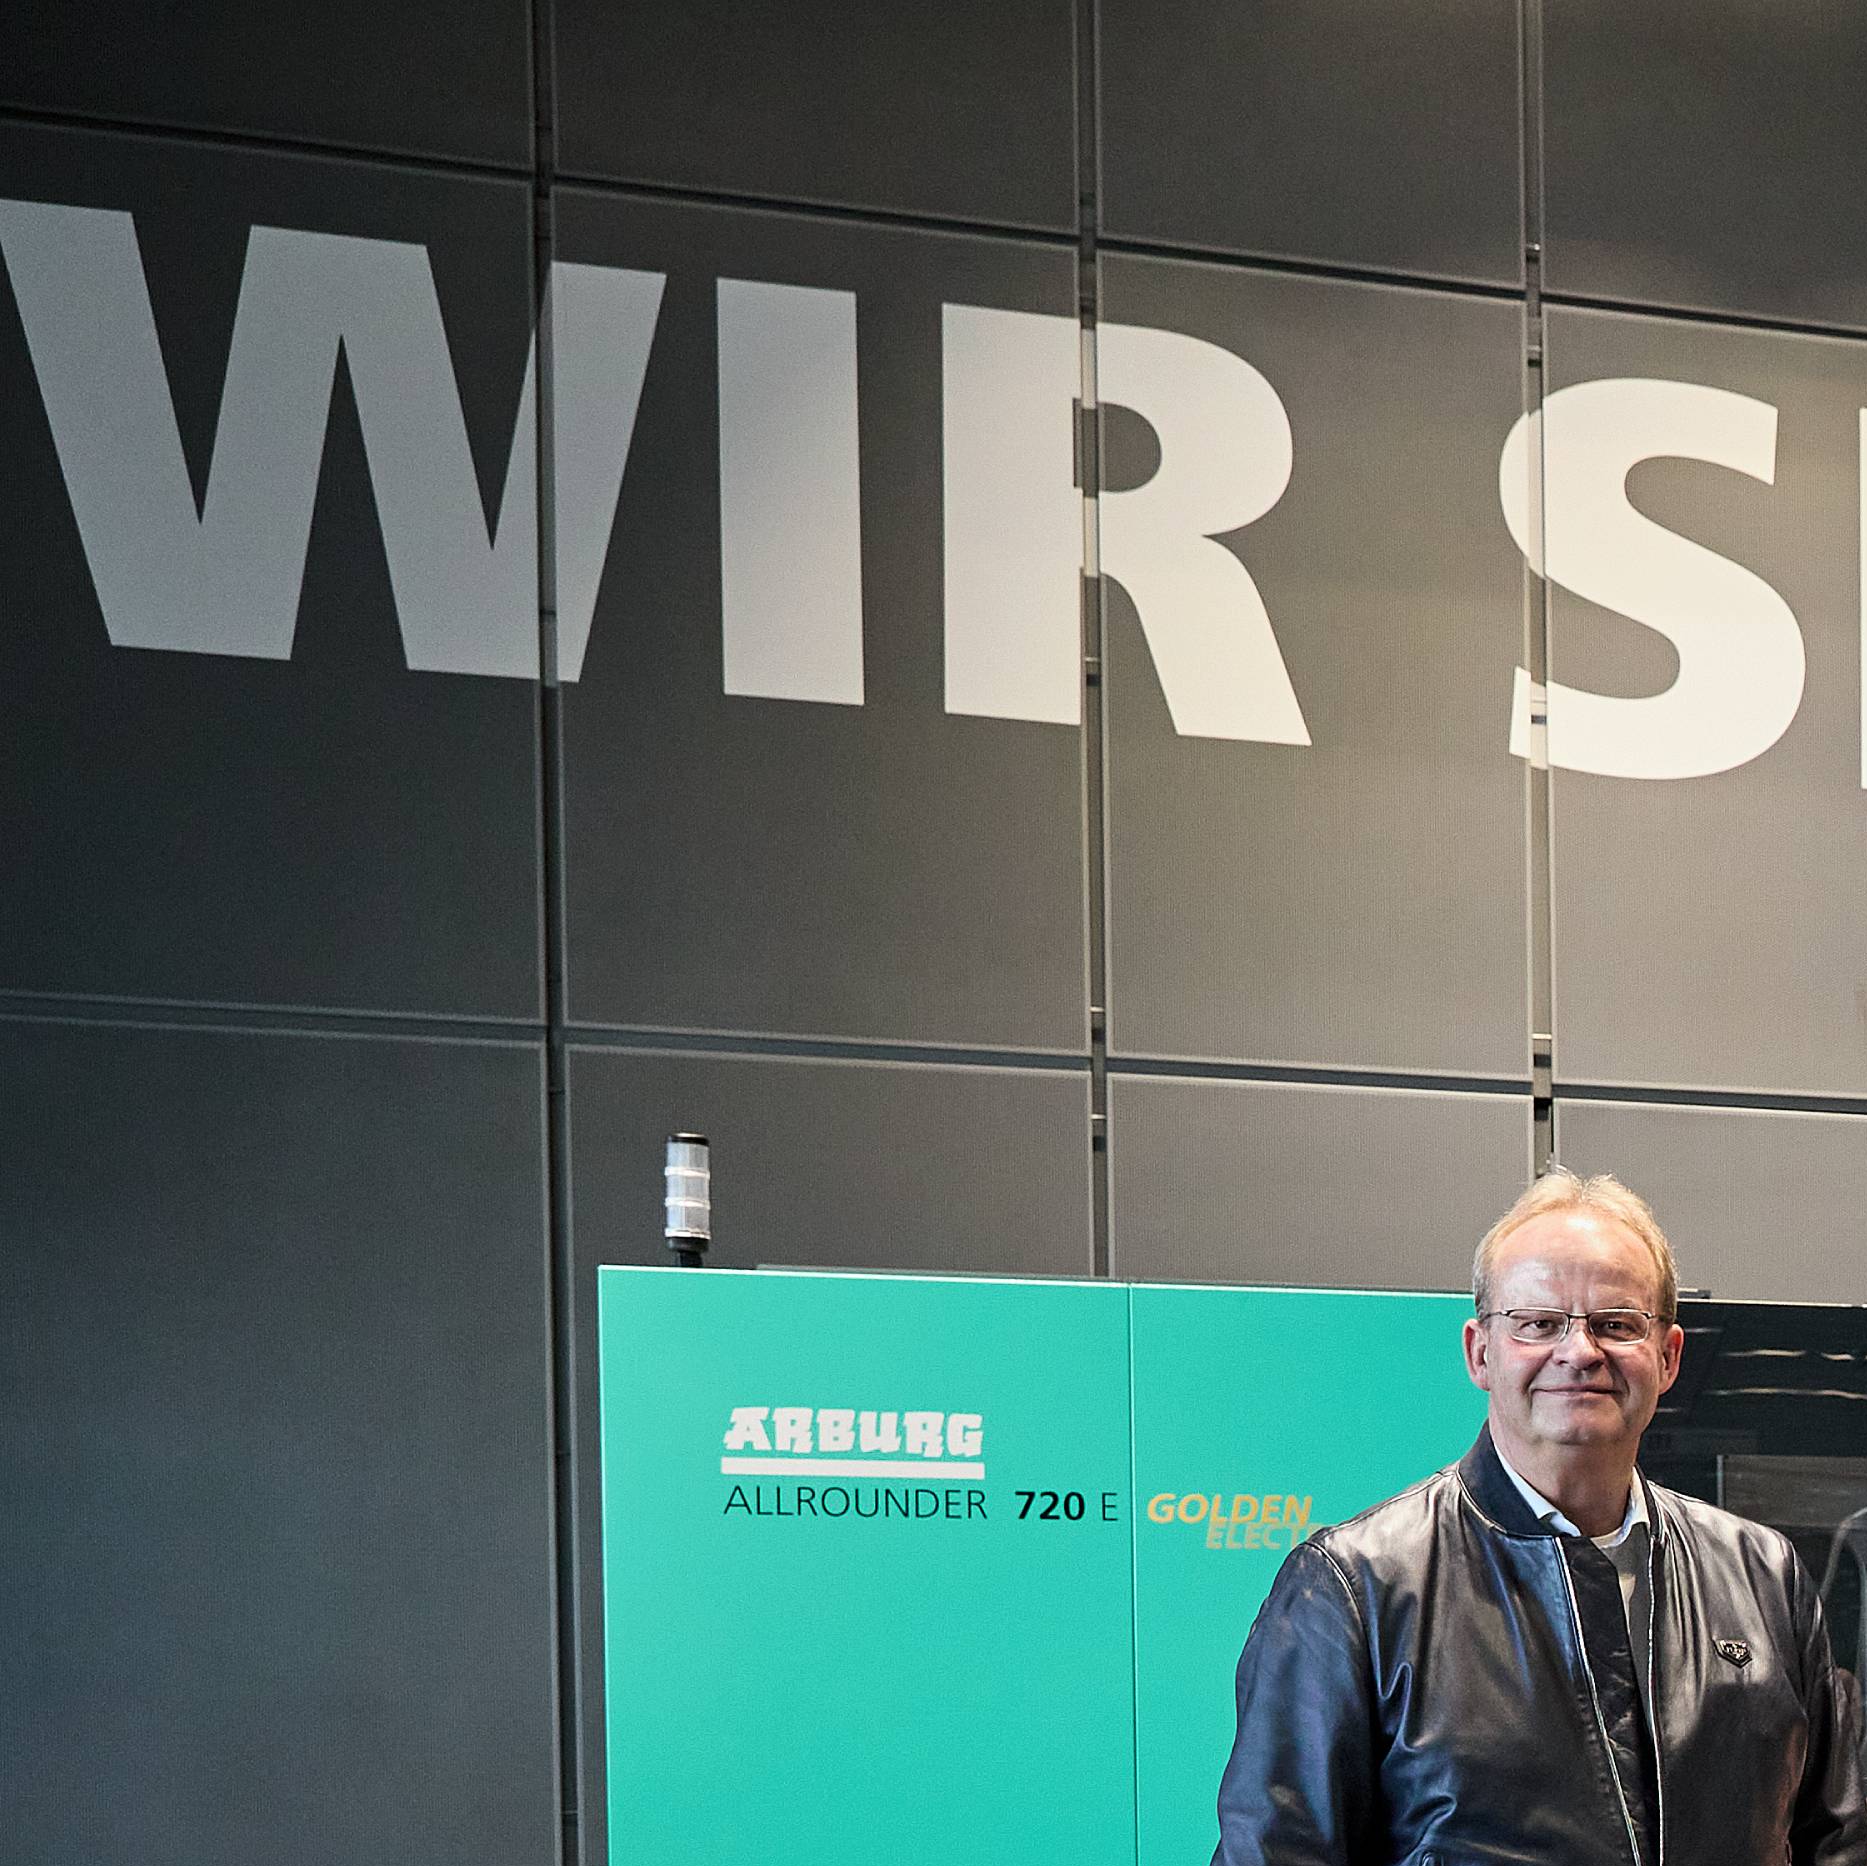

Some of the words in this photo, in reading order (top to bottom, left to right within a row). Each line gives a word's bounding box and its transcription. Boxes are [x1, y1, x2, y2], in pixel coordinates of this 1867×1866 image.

[0, 199, 1312, 746] WIR
[723, 1406, 984, 1457] ARBURG
[723, 1485, 988, 1521] ALLROUNDER
[1015, 1491, 1085, 1520] 720
[1101, 1492, 1119, 1521] E
[1147, 1494, 1313, 1526] GOLDEN
